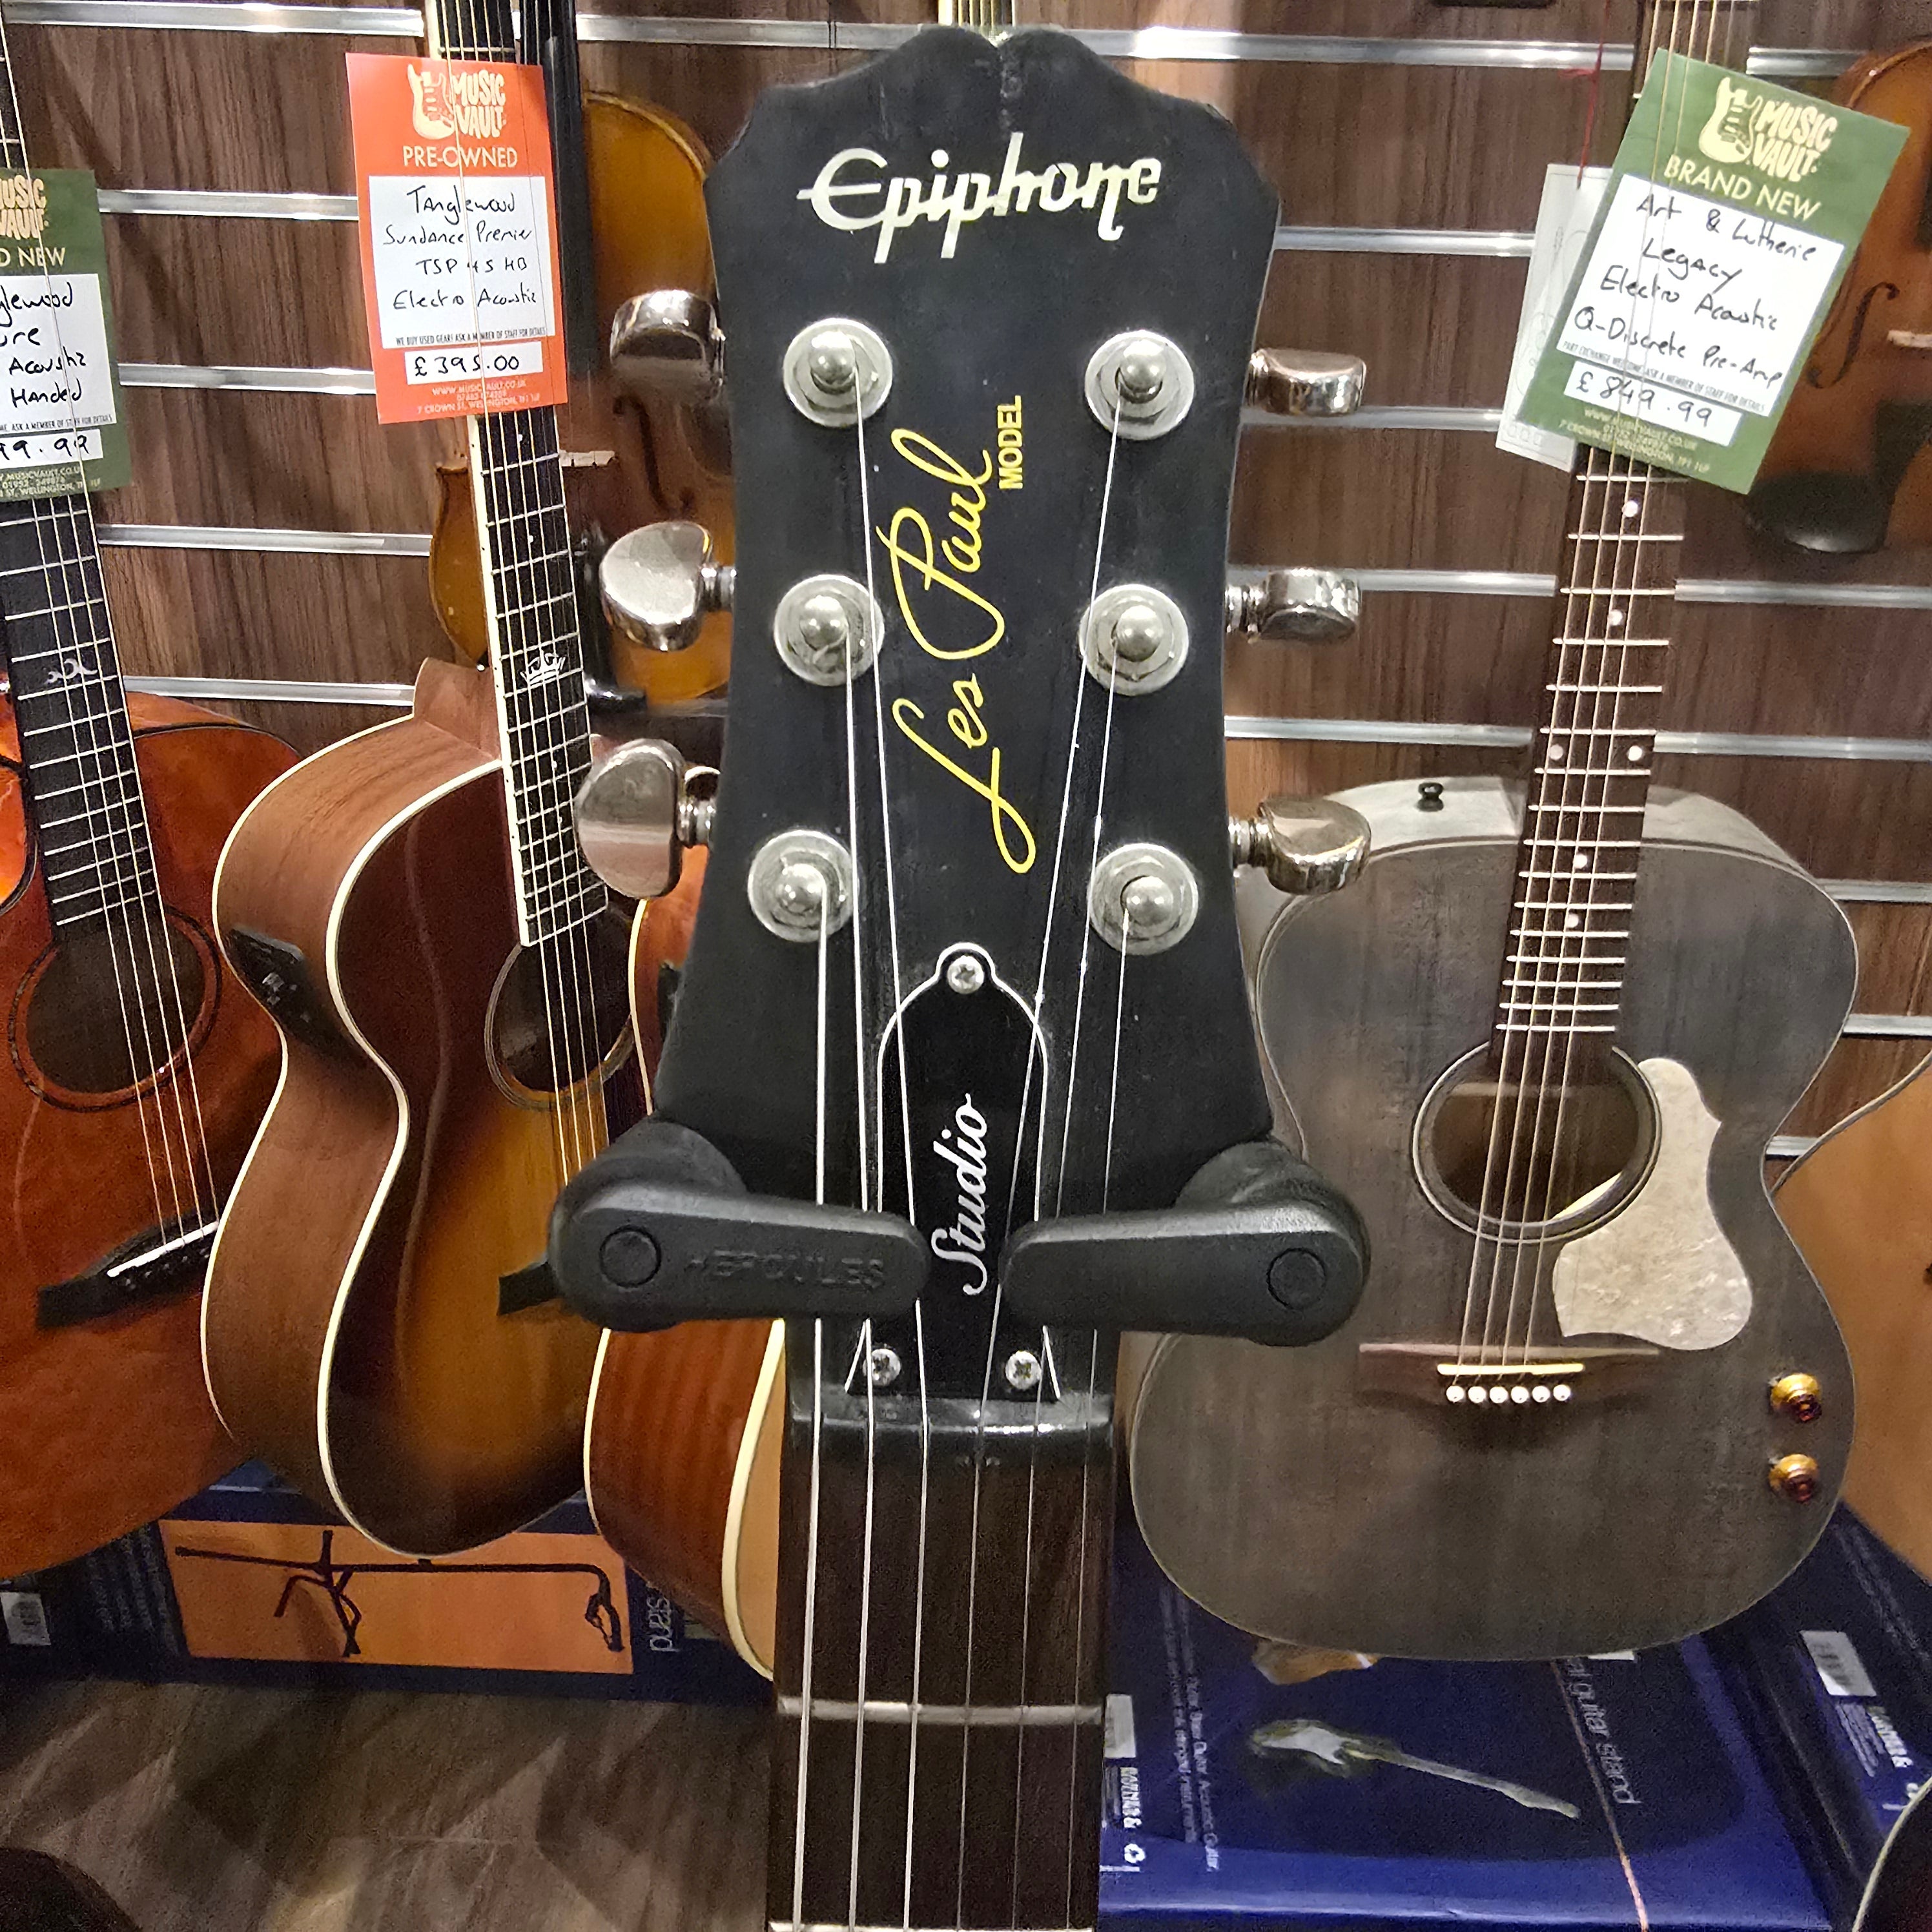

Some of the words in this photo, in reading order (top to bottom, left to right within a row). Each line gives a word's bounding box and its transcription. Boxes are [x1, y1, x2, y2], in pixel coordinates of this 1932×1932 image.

[451, 69, 506, 107] MUSIC
[455, 105, 504, 139] VAULT
[1754, 99, 1838, 152] MUSIC
[403, 145, 518, 168] PRE-OWNED
[406, 185, 515, 225] Tanglewood
[796, 131, 1162, 264] Epiphone
[1663, 154, 1752, 200] BRAND
[1756, 183, 1822, 222] NEW
[383, 223, 465, 245] Sundance
[1636, 192, 1683, 220] Art
[1705, 208, 1721, 234] &
[17, 246, 66, 267] NEW
[415, 258, 458, 275] TSP
[1641, 237, 1743, 294] Legacy
[1599, 264, 1680, 303] Electro
[1694, 293, 1778, 331] Acoustic
[415, 354, 520, 377] £395.00
[1702, 345, 1783, 389] Pre-Amp
[11, 377, 82, 408] Handed
[1576, 371, 1712, 427] £849.99
[998, 395, 1023, 489] MODEL
[876, 427, 1006, 661] Paul
[893, 672, 1036, 874] Les
[930, 1093, 988, 1296] Studio
